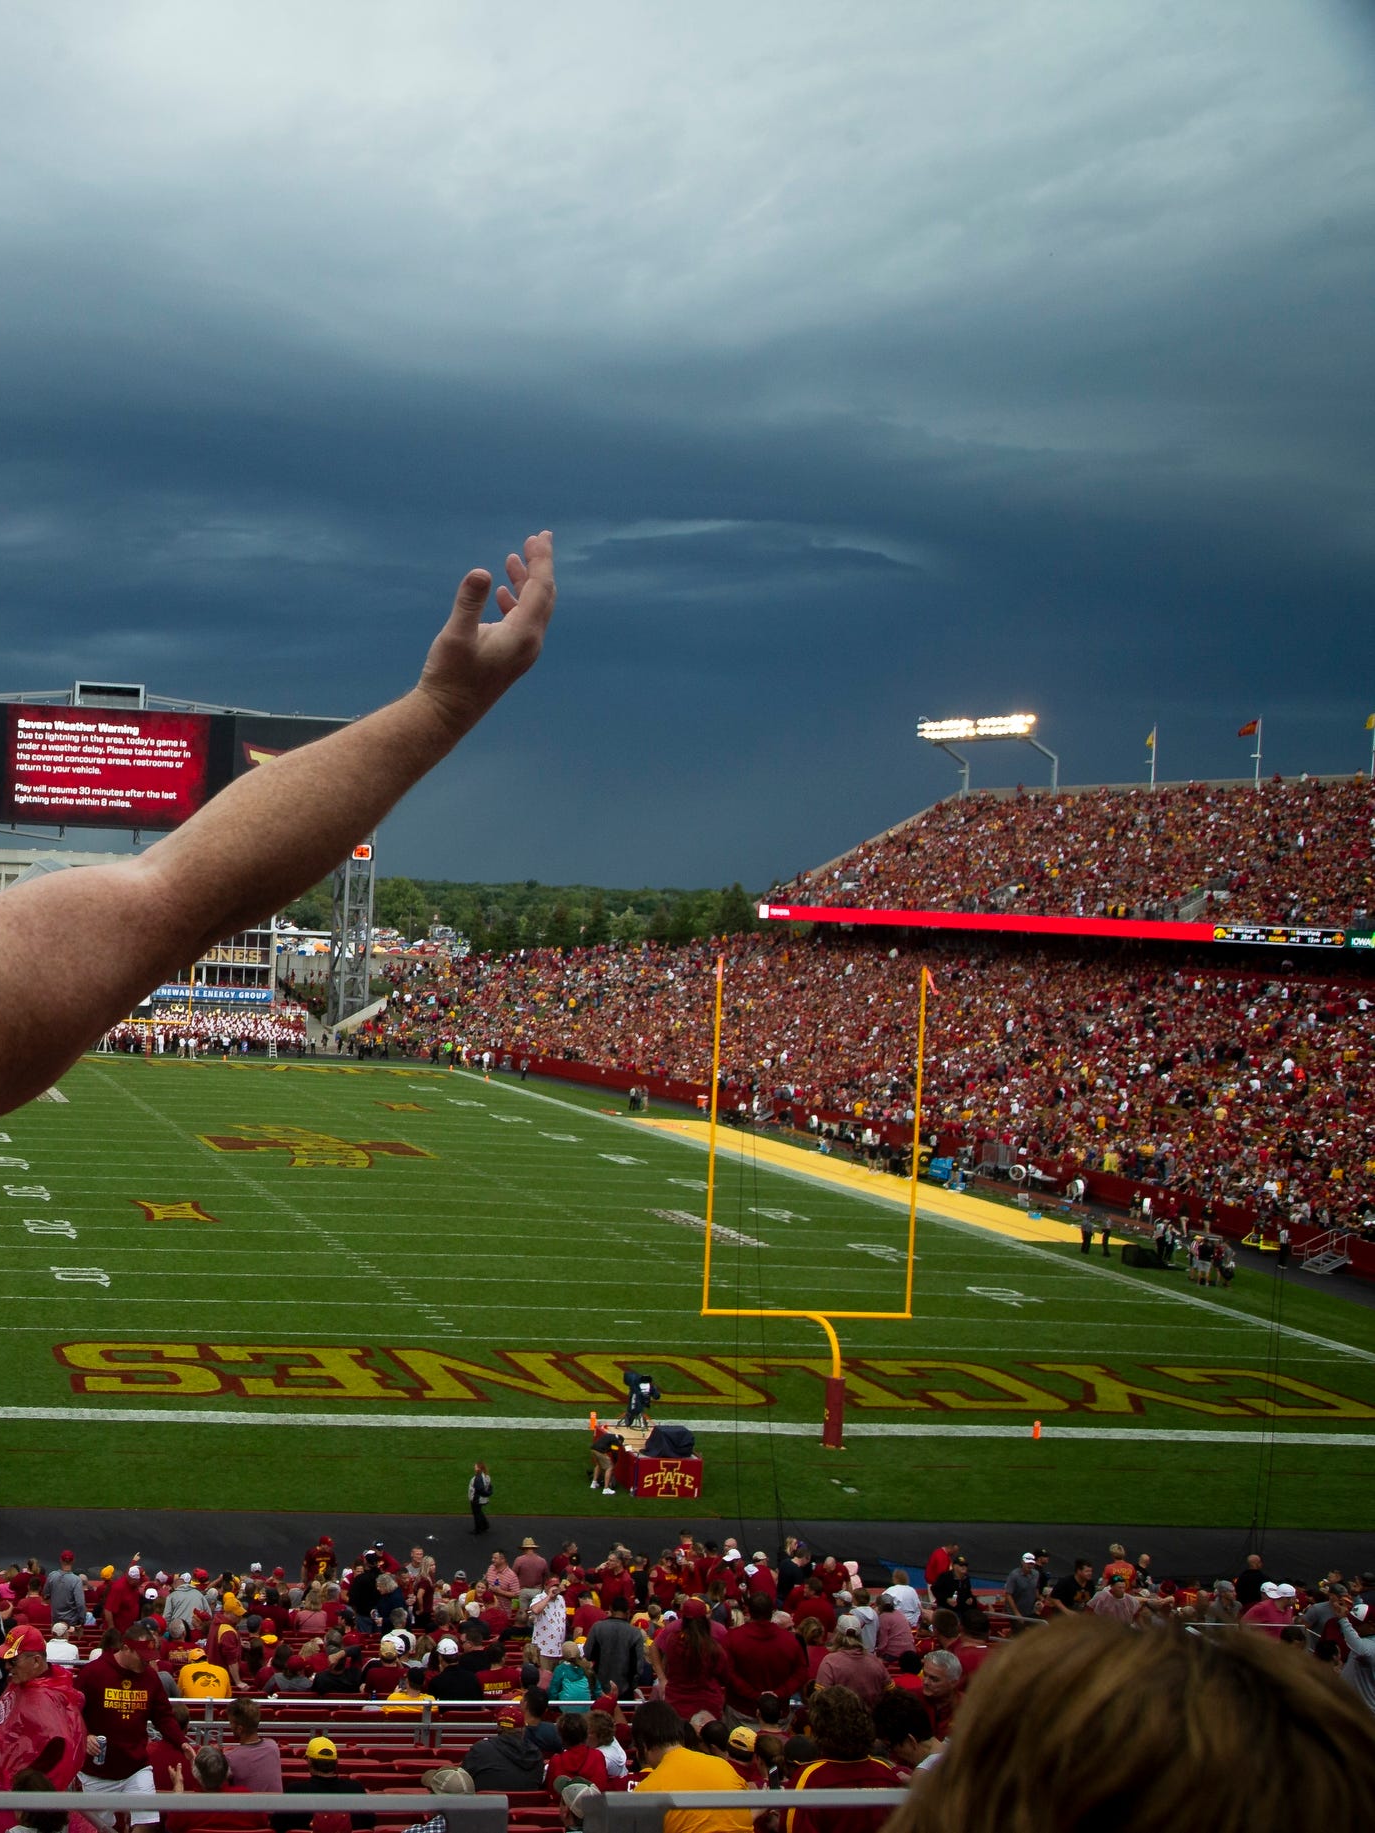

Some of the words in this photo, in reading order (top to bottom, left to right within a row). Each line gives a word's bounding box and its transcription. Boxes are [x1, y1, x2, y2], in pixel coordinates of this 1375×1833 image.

[18, 719, 52, 729] Severe
[54, 721, 96, 732] Weather
[98, 723, 139, 735] Warning
[18, 731, 33, 739] Due
[45, 732, 79, 743] lightning
[81, 734, 88, 742] in
[90, 734, 102, 742] the
[127, 736, 155, 746] today's
[157, 740, 178, 748] game
[180, 739, 187, 747] is
[17, 742, 40, 750] under
[48, 744, 80, 752] weather
[83, 745, 105, 755] delay.
[107, 746, 132, 755] Please
[154, 749, 181, 758] shelter
[183, 750, 190, 758] in
[17, 752, 30, 760] the
[32, 753, 63, 762] covered
[65, 756, 105, 764] concourse
[107, 758, 131, 766] areas,
[133, 759, 173, 768] restrooms
[53, 766, 70, 774] your
[72, 766, 101, 774] vehicle.
[15, 784, 31, 794] Play
[33, 785, 46, 793] will
[48, 786, 77, 794] resume
[79, 787, 90, 795] 30
[92, 787, 123, 796] minutes
[125, 789, 145, 798] after
[147, 790, 160, 798] the
[162, 791, 176, 799] last
[15, 794, 49, 805] lightning
[51, 797, 74, 805] strike
[76, 798, 100, 806] within
[101, 798, 107, 806] 8
[109, 799, 131, 808] miles.
[203, 990, 236, 999] ENERGY
[238, 991, 267, 999] GROUP
[23, 1219, 77, 1236] 20
[50, 1266, 111, 1283] 10
[52, 1339, 1375, 1417] CYCLONES
[643, 1472, 695, 1489] STATE
[106, 1689, 147, 1700] CYCLONE
[104, 1701, 147, 1710] BASKETBALL
